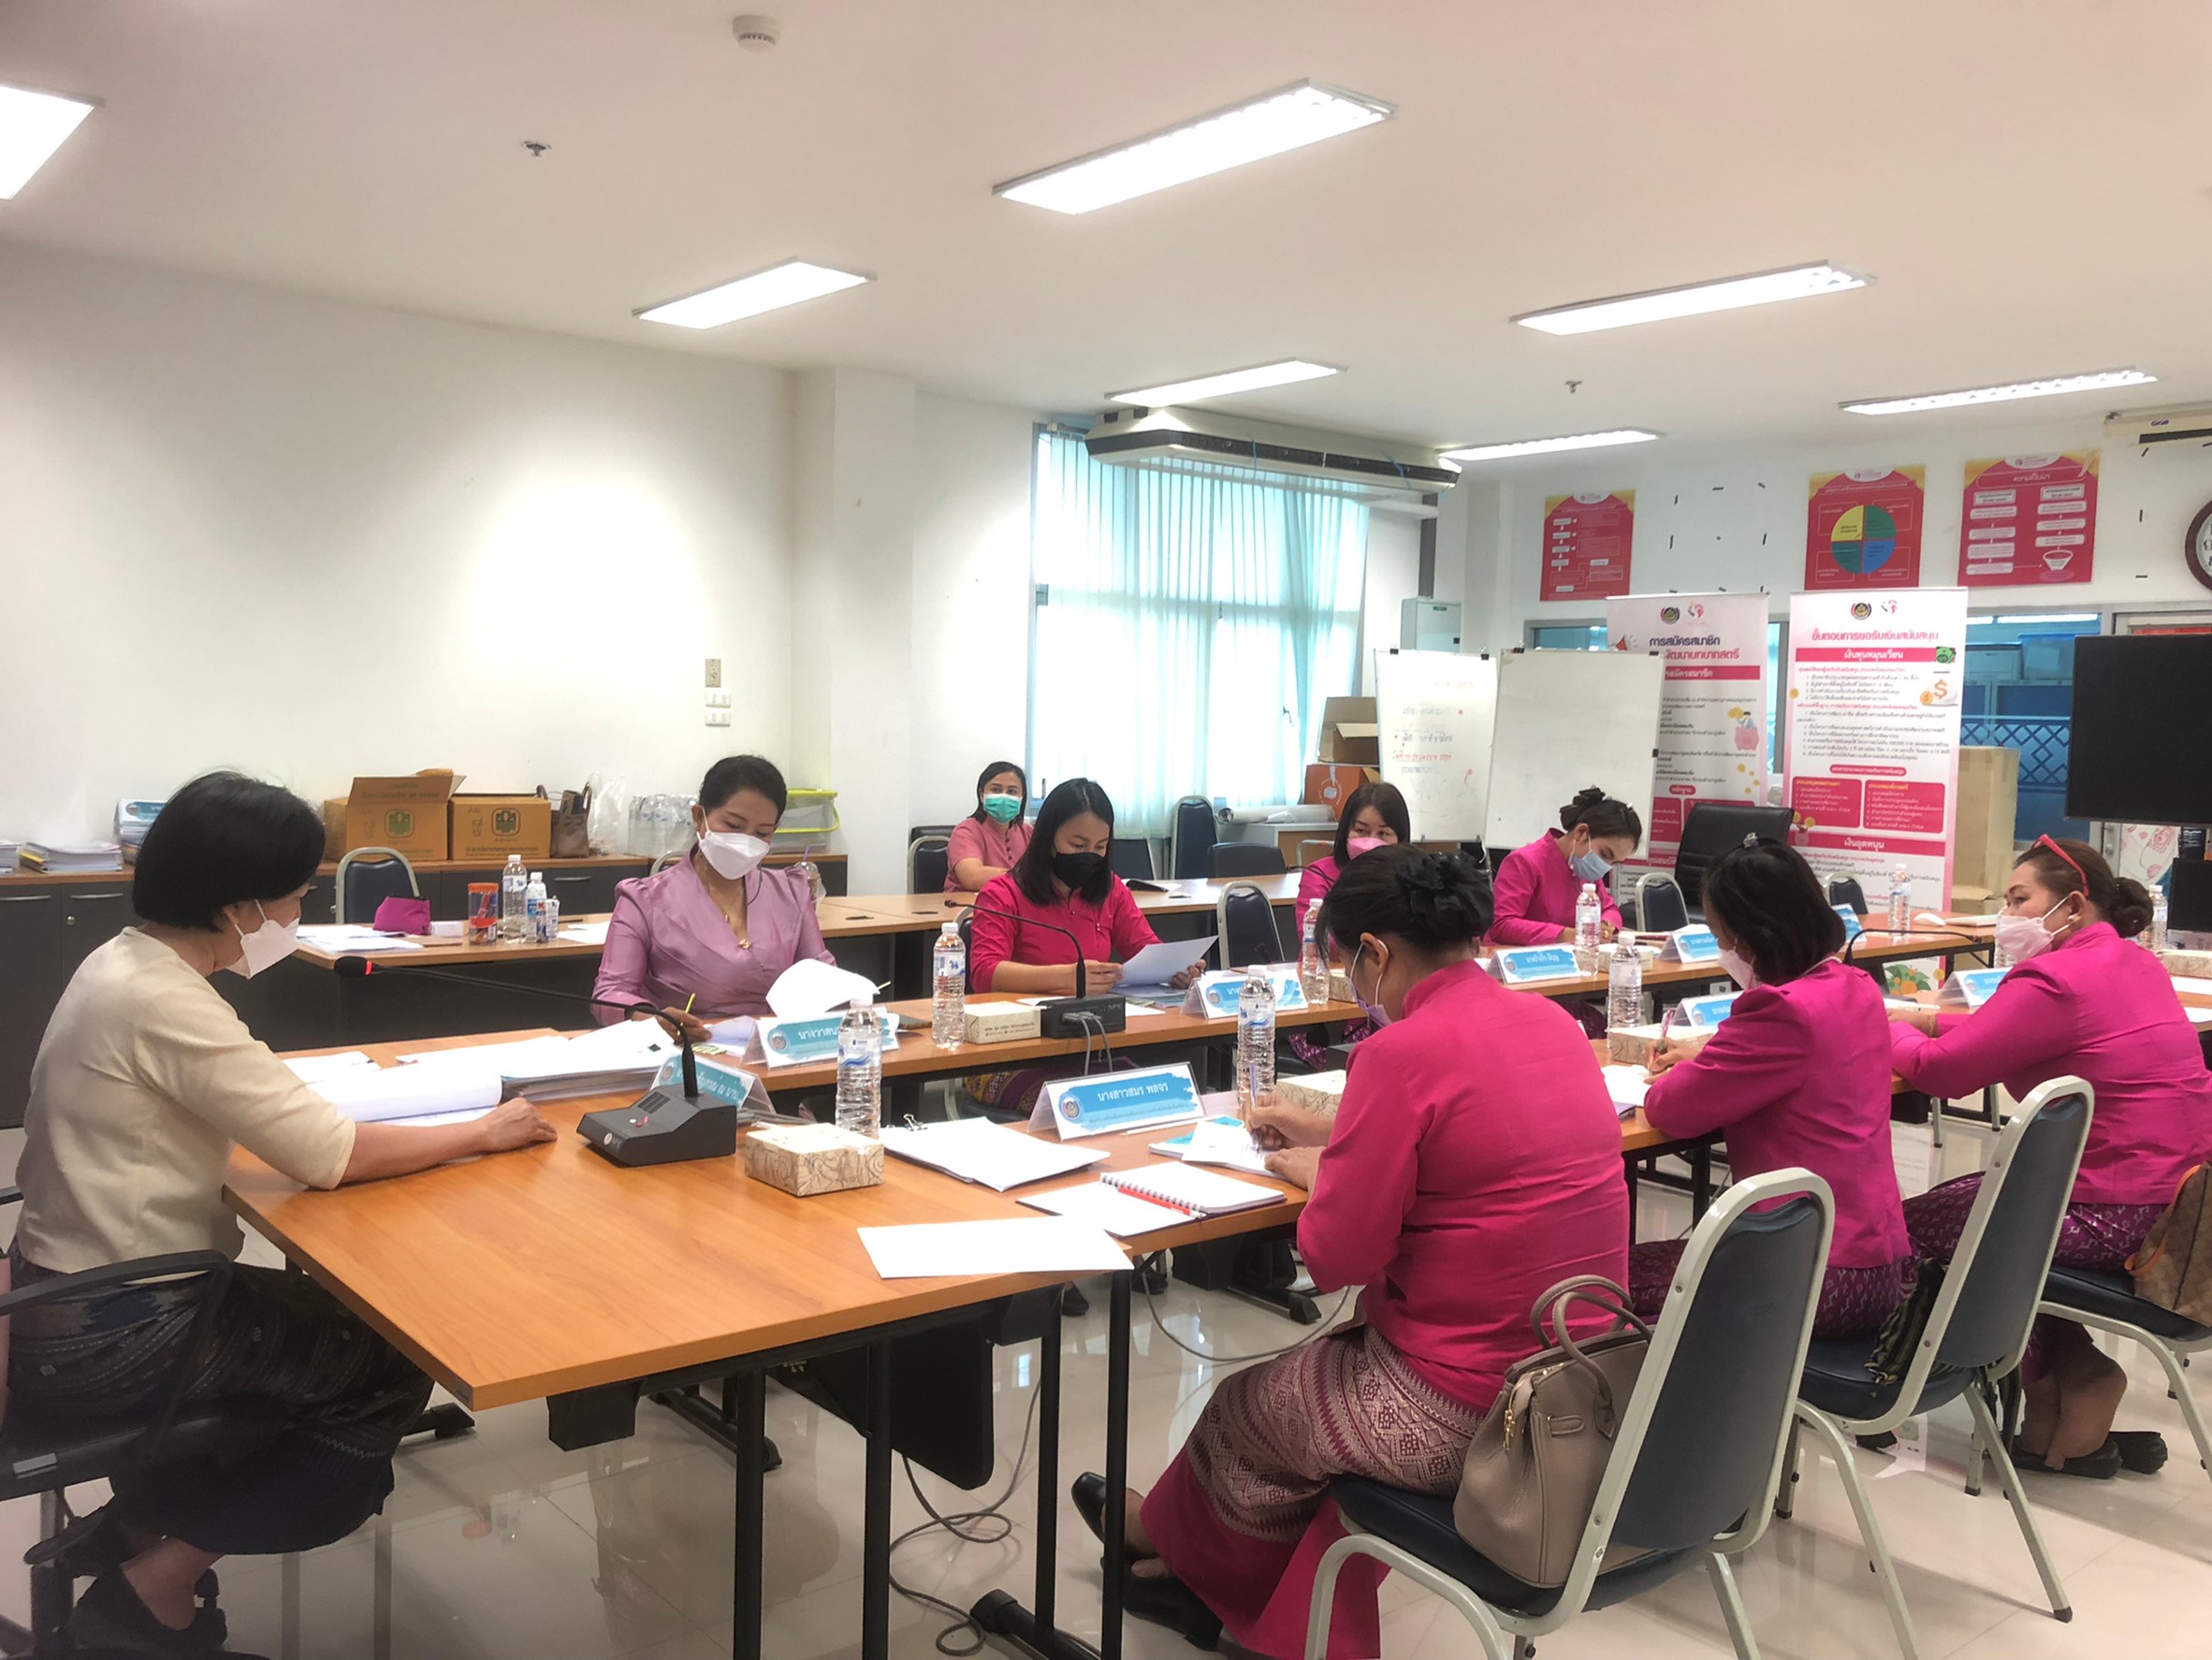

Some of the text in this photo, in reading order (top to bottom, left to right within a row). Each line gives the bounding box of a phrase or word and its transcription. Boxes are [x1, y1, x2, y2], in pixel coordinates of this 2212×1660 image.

[1649, 634, 1721, 647] การสมัครสมาชิก
[1812, 627, 1939, 643] ขั้นตอนการขอรับเงินสนับสนุน
[1665, 648, 1740, 661] ัฒนาบทบาทสตรี
[1843, 648, 1904, 663] เงินทุนหมุนเวียน
[1843, 837, 1885, 852] เงินอุดหนุน
[1097, 1085, 1144, 1102] นางสาวสมร
